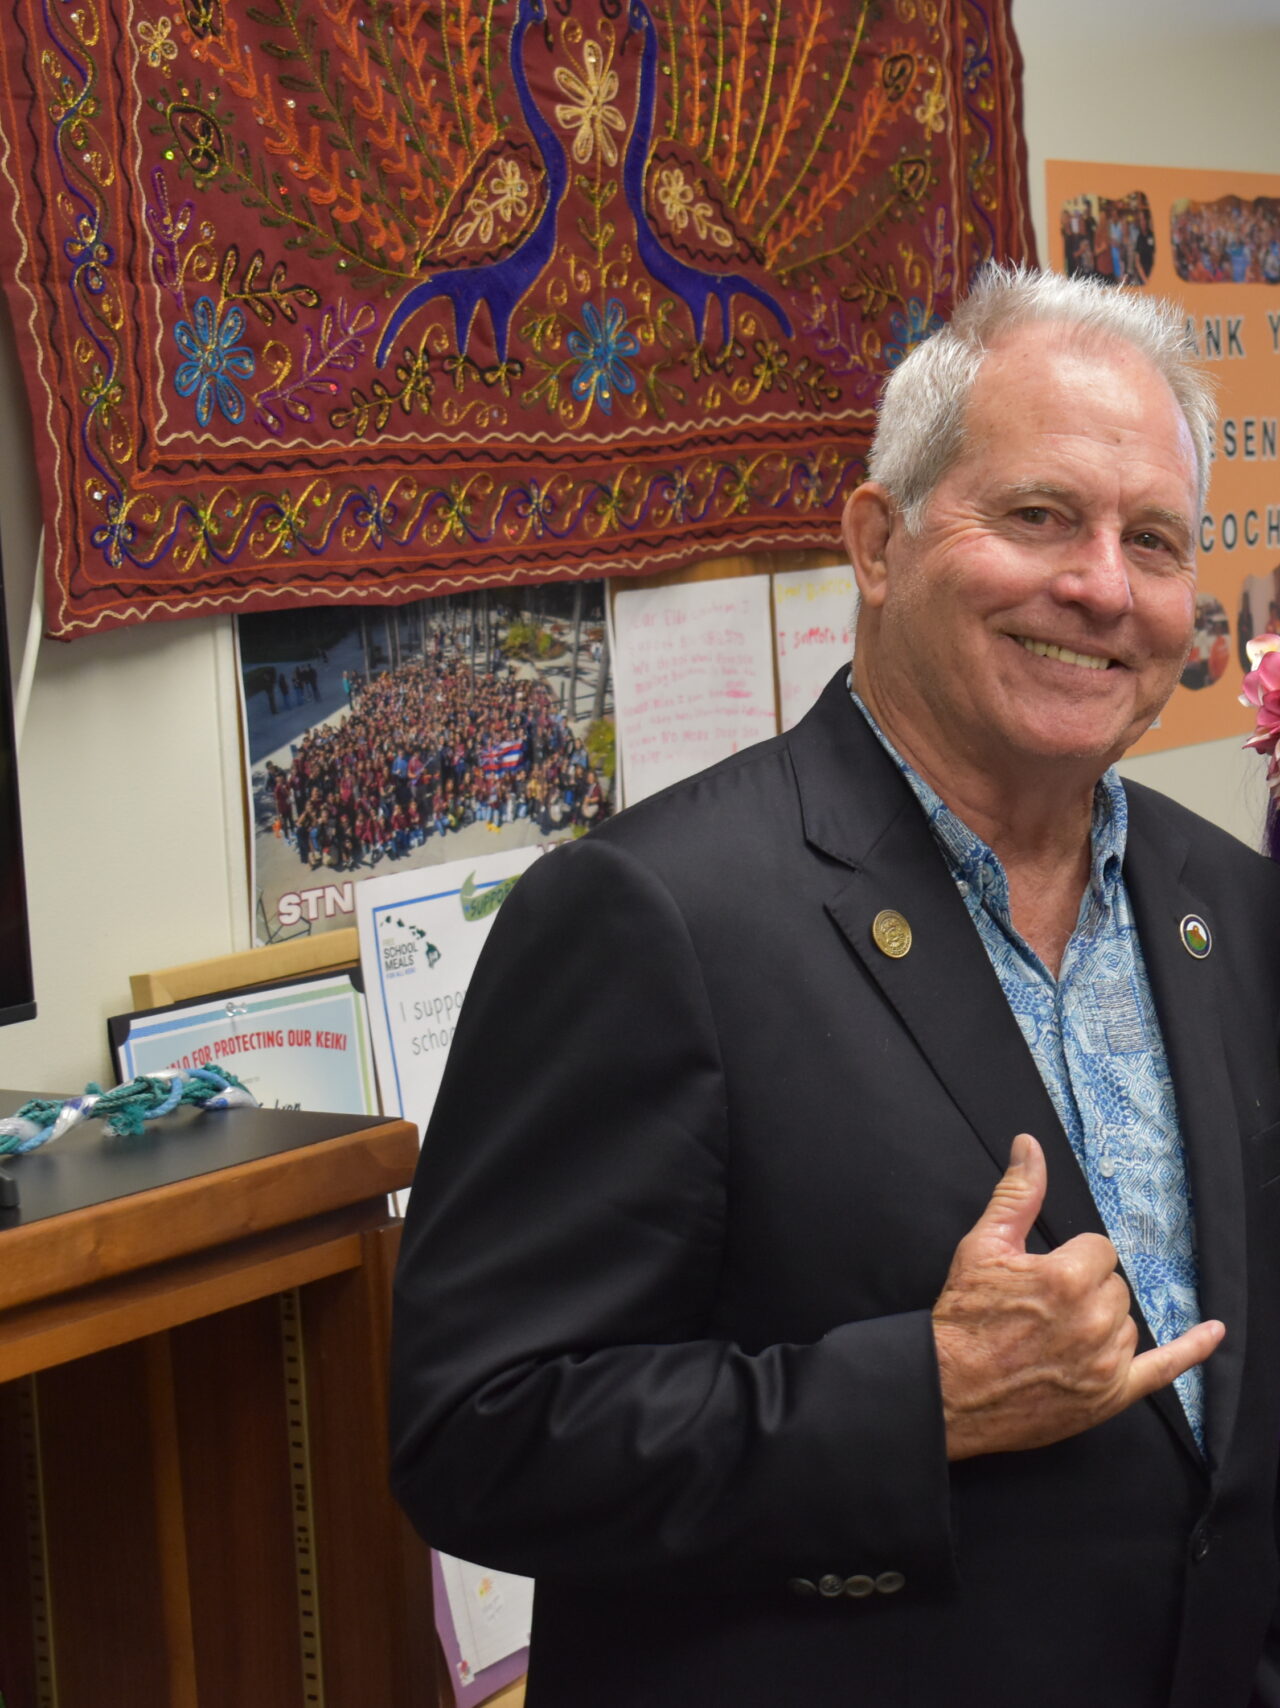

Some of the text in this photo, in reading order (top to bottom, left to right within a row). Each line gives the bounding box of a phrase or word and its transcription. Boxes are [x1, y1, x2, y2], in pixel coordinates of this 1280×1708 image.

[1185, 319, 1244, 356] ANK
[278, 882, 355, 926] STN
[384, 942, 419, 959] SCHOOL
[384, 954, 415, 971] MEALS
[413, 990, 467, 1024] suppo
[192, 1045, 213, 1068] FOR
[213, 1030, 284, 1059] PROTECTING
[288, 1029, 312, 1047] OUR
[315, 1030, 347, 1051] KEIKI
